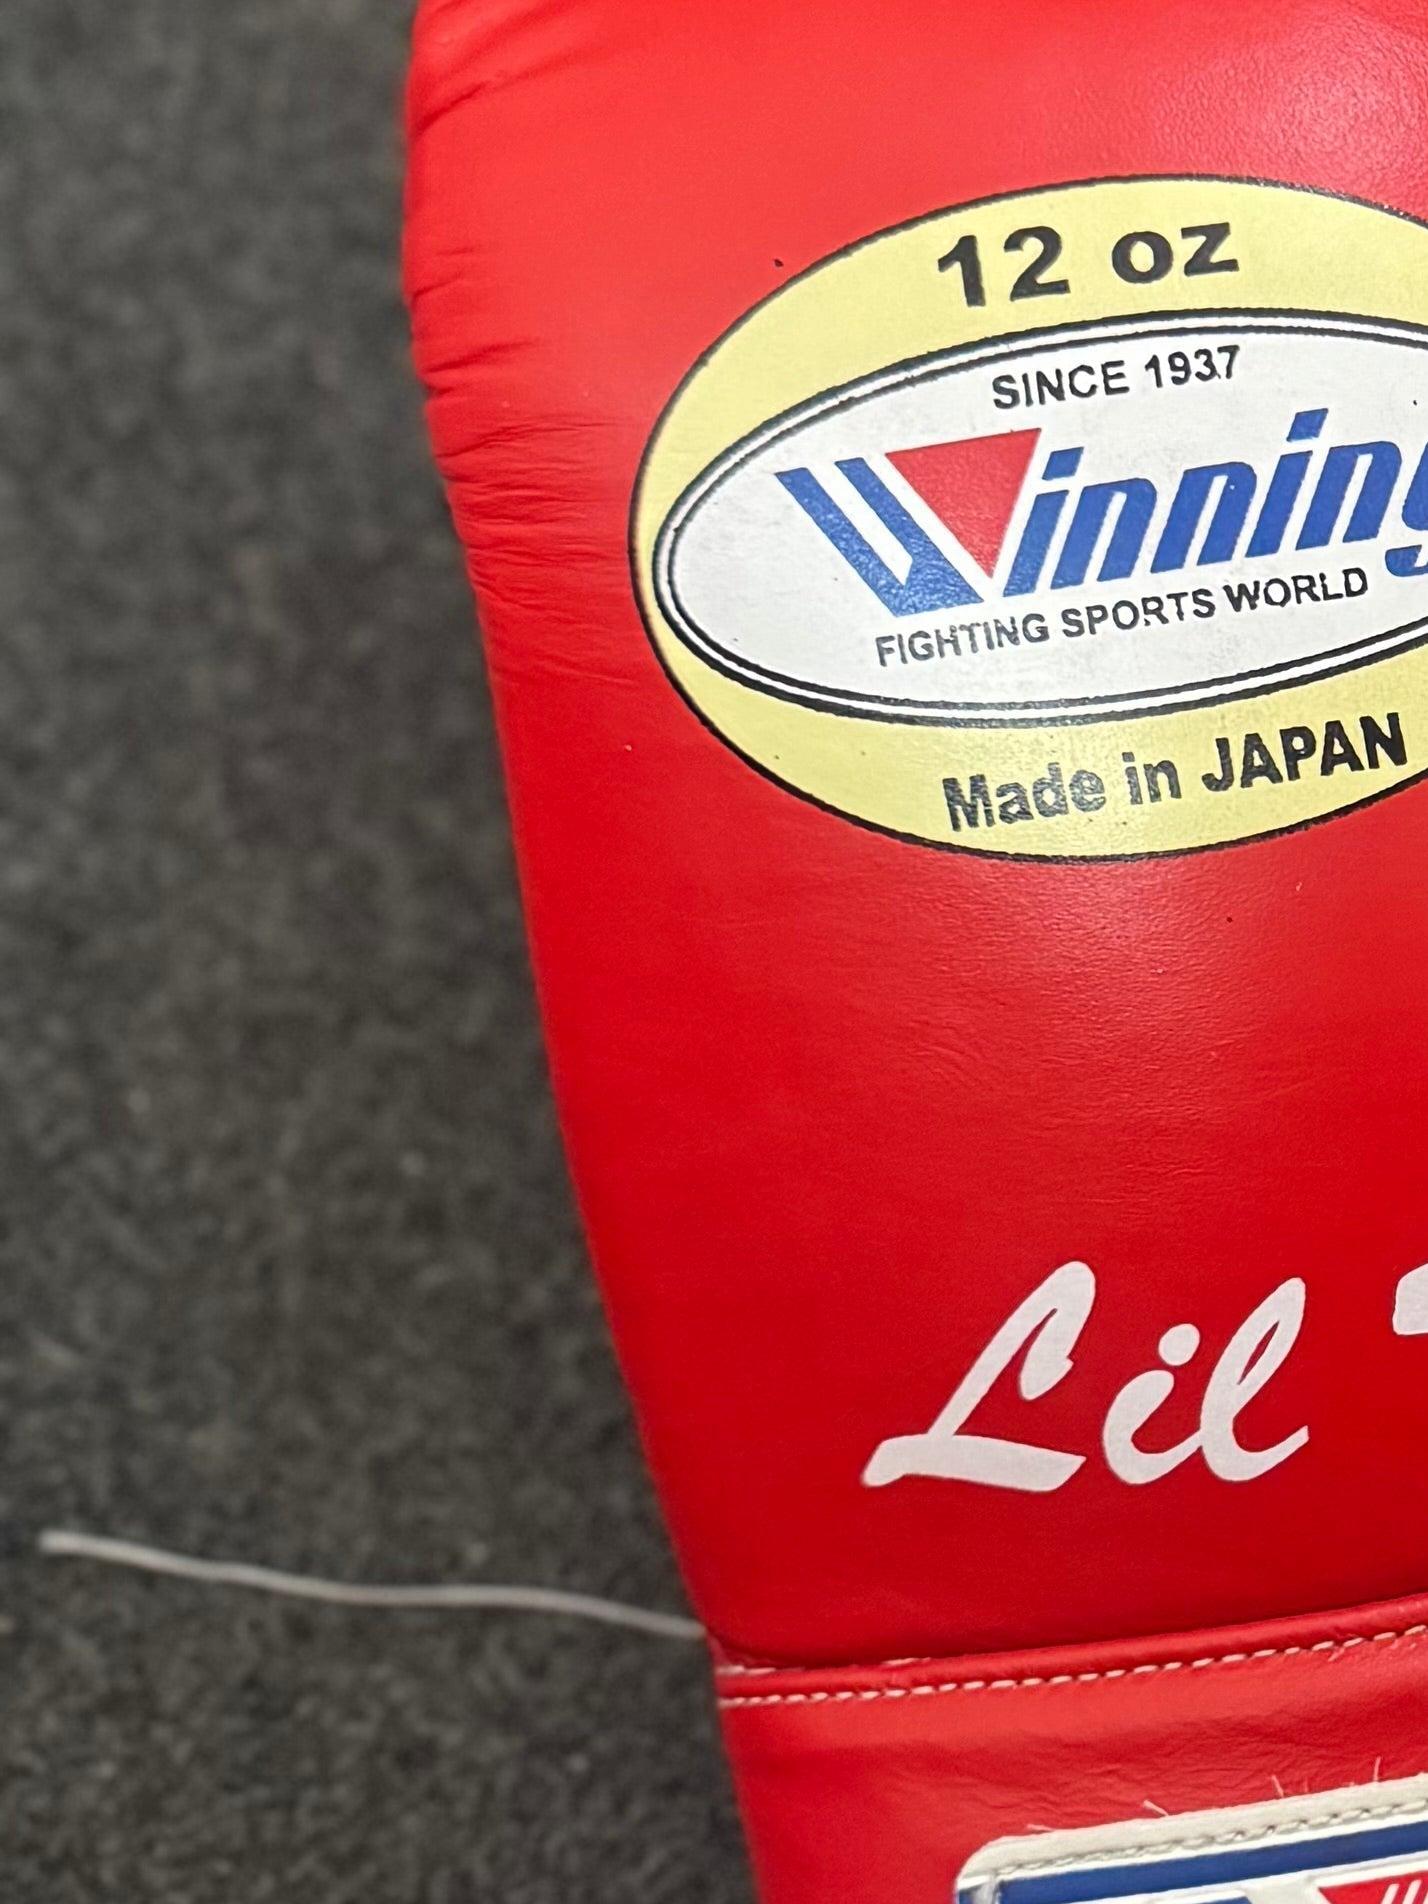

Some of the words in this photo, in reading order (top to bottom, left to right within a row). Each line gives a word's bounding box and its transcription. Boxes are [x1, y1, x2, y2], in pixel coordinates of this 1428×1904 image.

[938, 226, 1070, 306] 12
[1112, 223, 1238, 283] oz
[993, 360, 1129, 409] SINCE
[1145, 345, 1239, 388] 1937
[876, 614, 1049, 666] FIGHTING
[1062, 589, 1215, 637] SPORTS
[1223, 568, 1368, 612] WORLD
[942, 760, 1106, 831] Made
[1122, 752, 1181, 804] in
[1202, 712, 1407, 791] JAPAN
[861, 1261, 1309, 1492] Lil
